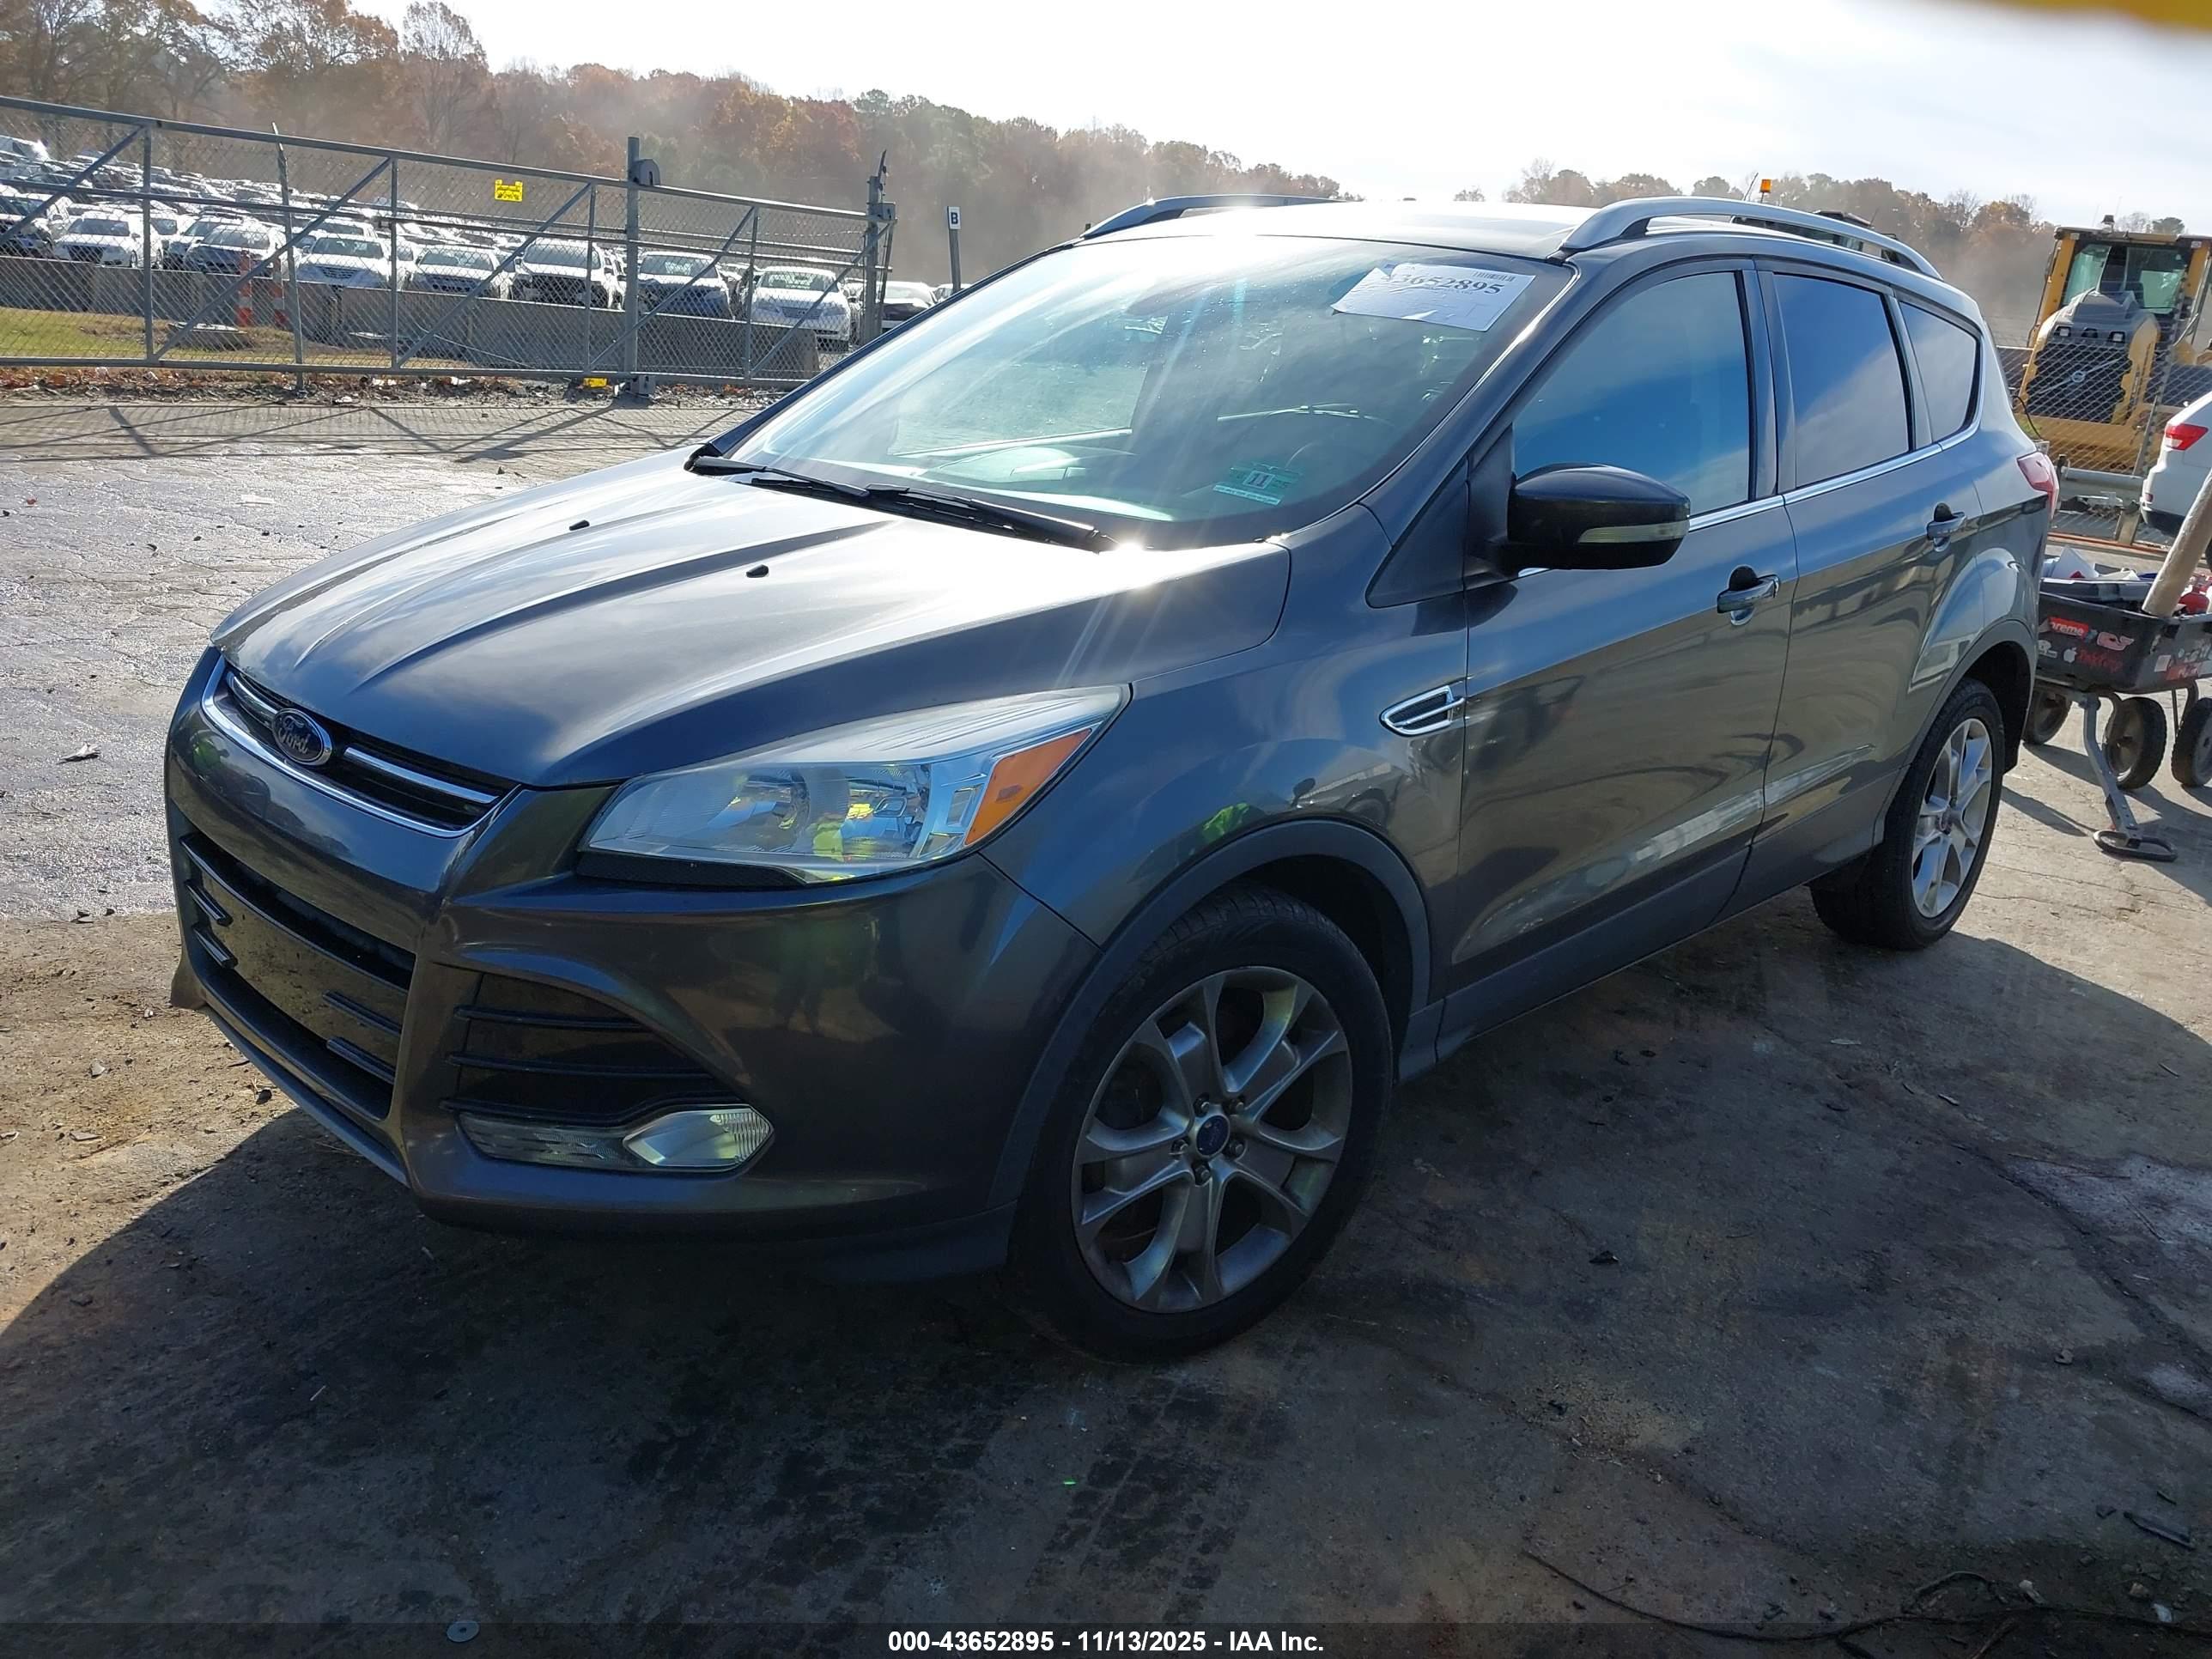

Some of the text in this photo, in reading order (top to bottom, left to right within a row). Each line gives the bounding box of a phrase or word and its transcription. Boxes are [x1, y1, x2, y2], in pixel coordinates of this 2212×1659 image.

[951, 212, 958, 224] B
[1381, 273, 1504, 295] 3652895
[278, 715, 310, 754] Ford
